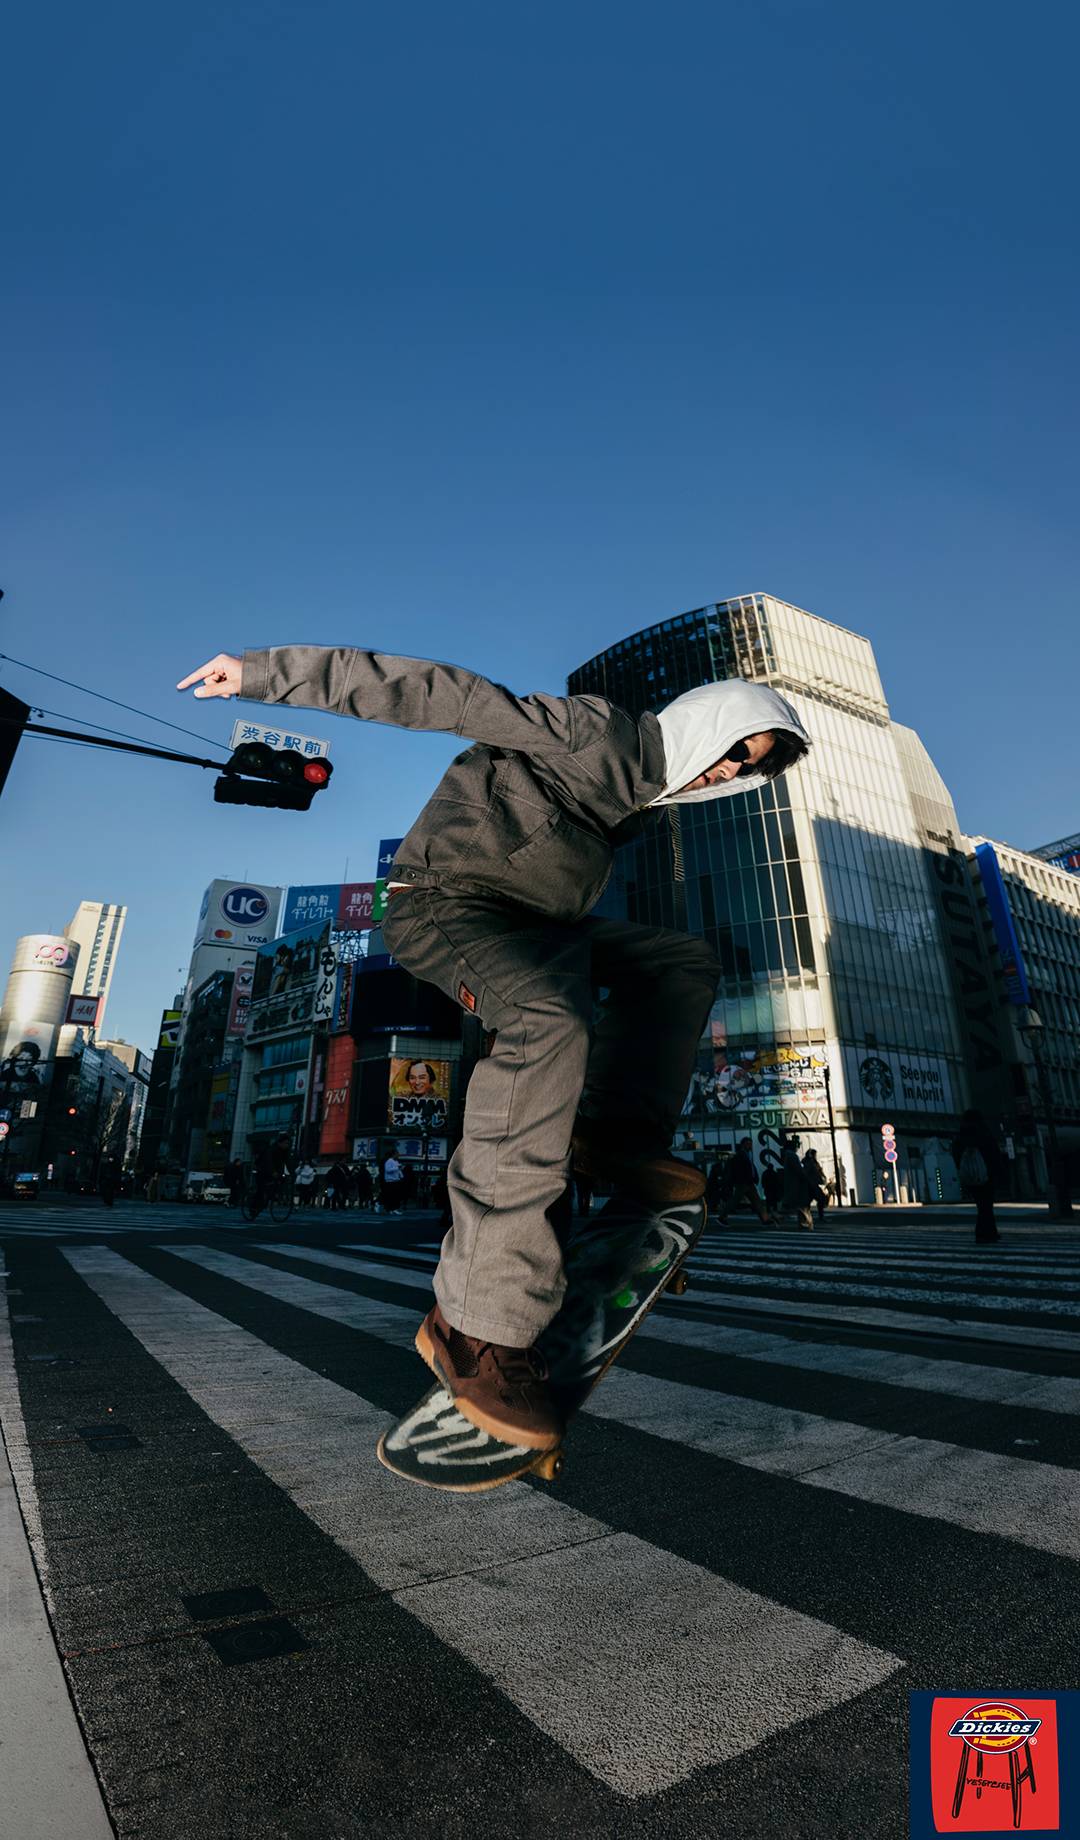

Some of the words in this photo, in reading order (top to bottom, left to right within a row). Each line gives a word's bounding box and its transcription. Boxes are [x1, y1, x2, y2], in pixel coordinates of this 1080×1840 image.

[240, 726, 322, 756] 渋谷駅前
[226, 895, 265, 916] UC
[247, 935, 267, 943] VISA
[315, 948, 337, 1017] もんじゃ
[900, 1065, 920, 1081] See
[920, 1069, 939, 1085] you
[903, 1085, 914, 1099] in
[916, 1086, 945, 1102] April!
[393, 1098, 446, 1114] DMM
[736, 1110, 830, 1128] TSUTAYA
